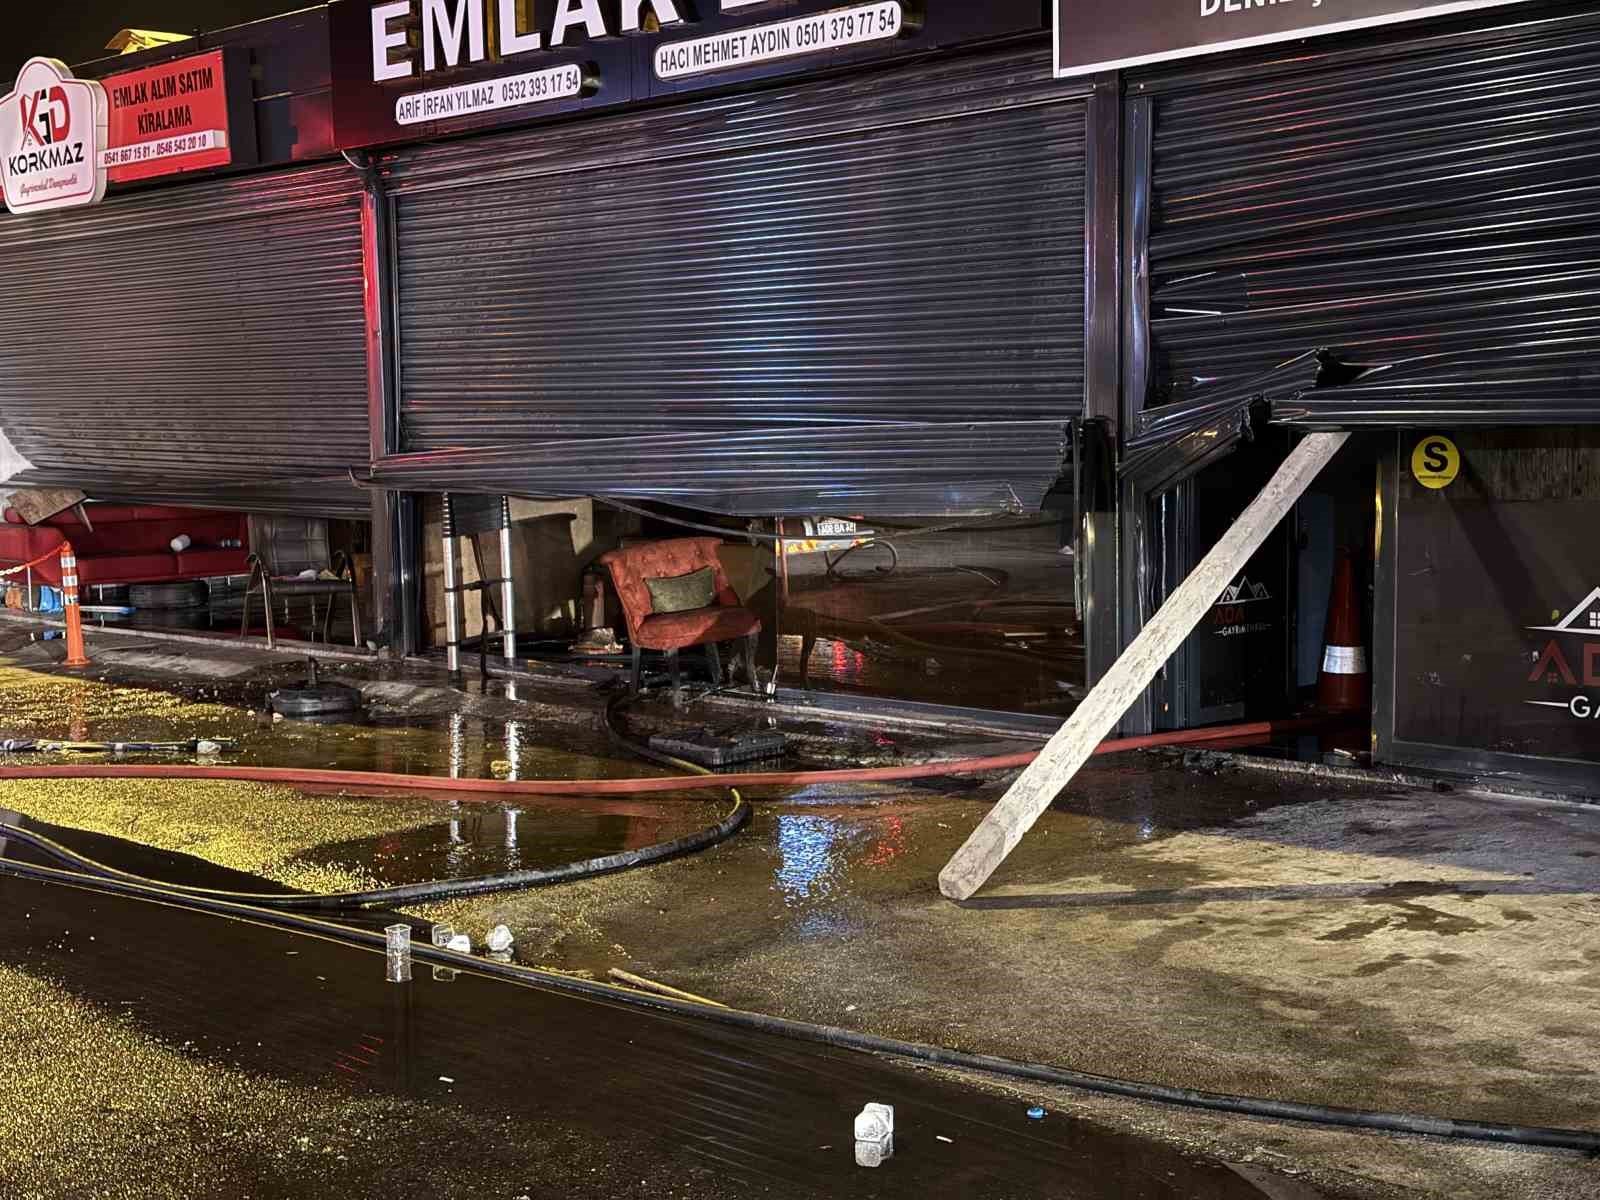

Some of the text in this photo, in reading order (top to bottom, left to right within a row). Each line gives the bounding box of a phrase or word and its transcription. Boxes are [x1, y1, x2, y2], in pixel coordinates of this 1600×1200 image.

[660, 7, 895, 73] HACI MEHMET AYDIN 0501 379 77 54
[113, 68, 213, 109] EMLAK ALIM SATIM
[398, 70, 579, 120] ARİF İRFAN YILMAZ 0532 393 17 54
[137, 105, 193, 135] KİRALAMA
[8, 142, 85, 176] KORKMAZ
[104, 152, 119, 164] 0541
[134, 147, 141, 159] 15
[1424, 442, 1448, 472] S
